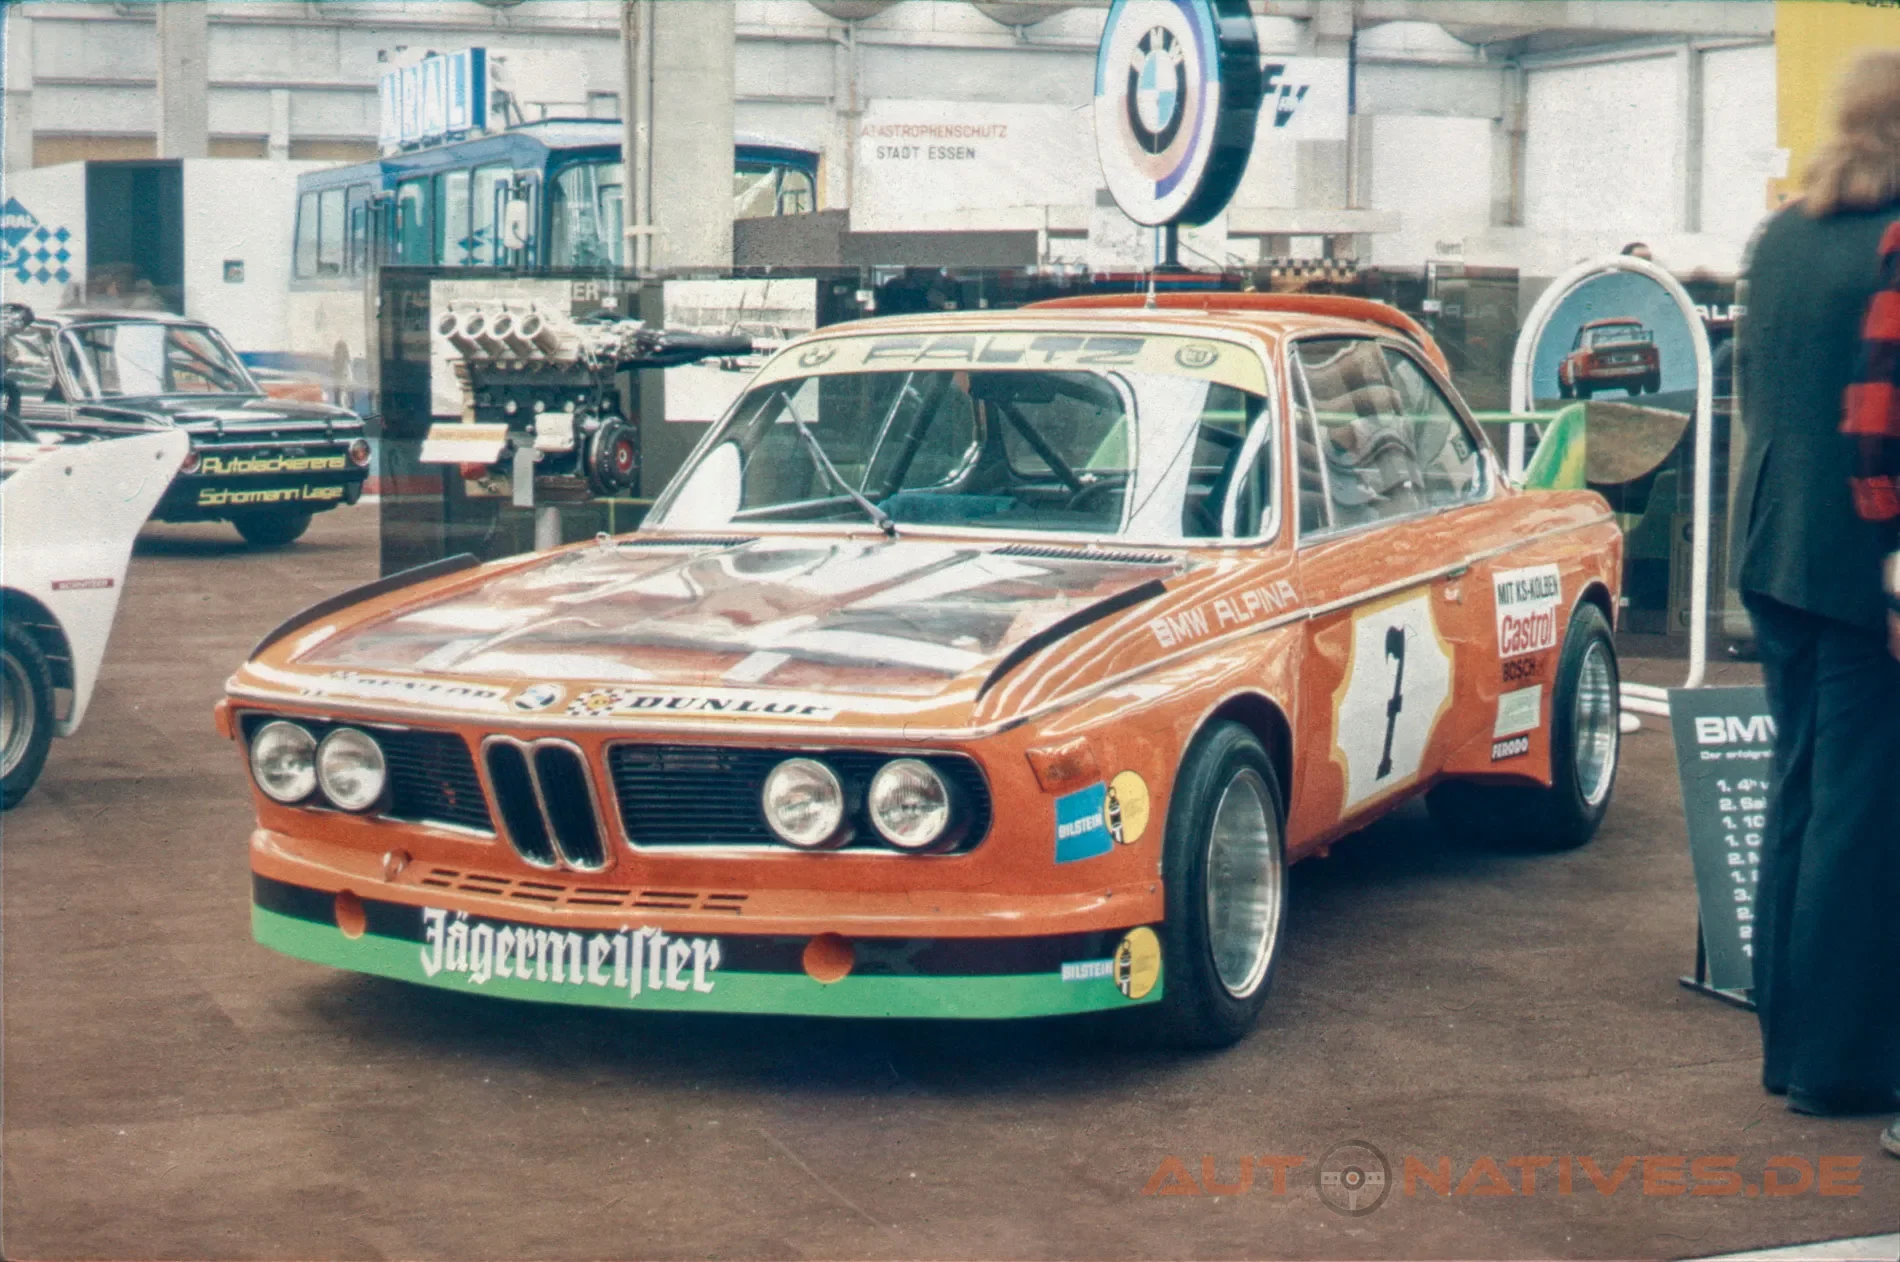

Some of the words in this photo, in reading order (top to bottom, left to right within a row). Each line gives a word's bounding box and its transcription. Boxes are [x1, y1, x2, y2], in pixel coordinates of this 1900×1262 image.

[860, 123, 1008, 138] ATASTROPHENSCHUTZ
[876, 146, 920, 159] STADT
[928, 146, 976, 159] ESSEN
[862, 336, 1147, 366] FALTZ
[1498, 583, 1515, 605] MIT
[1150, 606, 1209, 648] BMW
[1213, 579, 1300, 628] ALPINA
[1503, 609, 1553, 655] Castrol
[1503, 660, 1536, 683] BOSCH
[1493, 738, 1528, 760] FERODO
[1716, 779, 1731, 793] 1.
[1719, 797, 1737, 811] 2.
[1058, 811, 1103, 839] BILSTEIN
[1722, 815, 1737, 830] 1.
[1725, 833, 1740, 847] 1.
[1728, 852, 1745, 866] 2.
[1731, 870, 1746, 883] 1.
[1733, 888, 1752, 901] 3.
[1061, 960, 1114, 981] BILSTEIN
